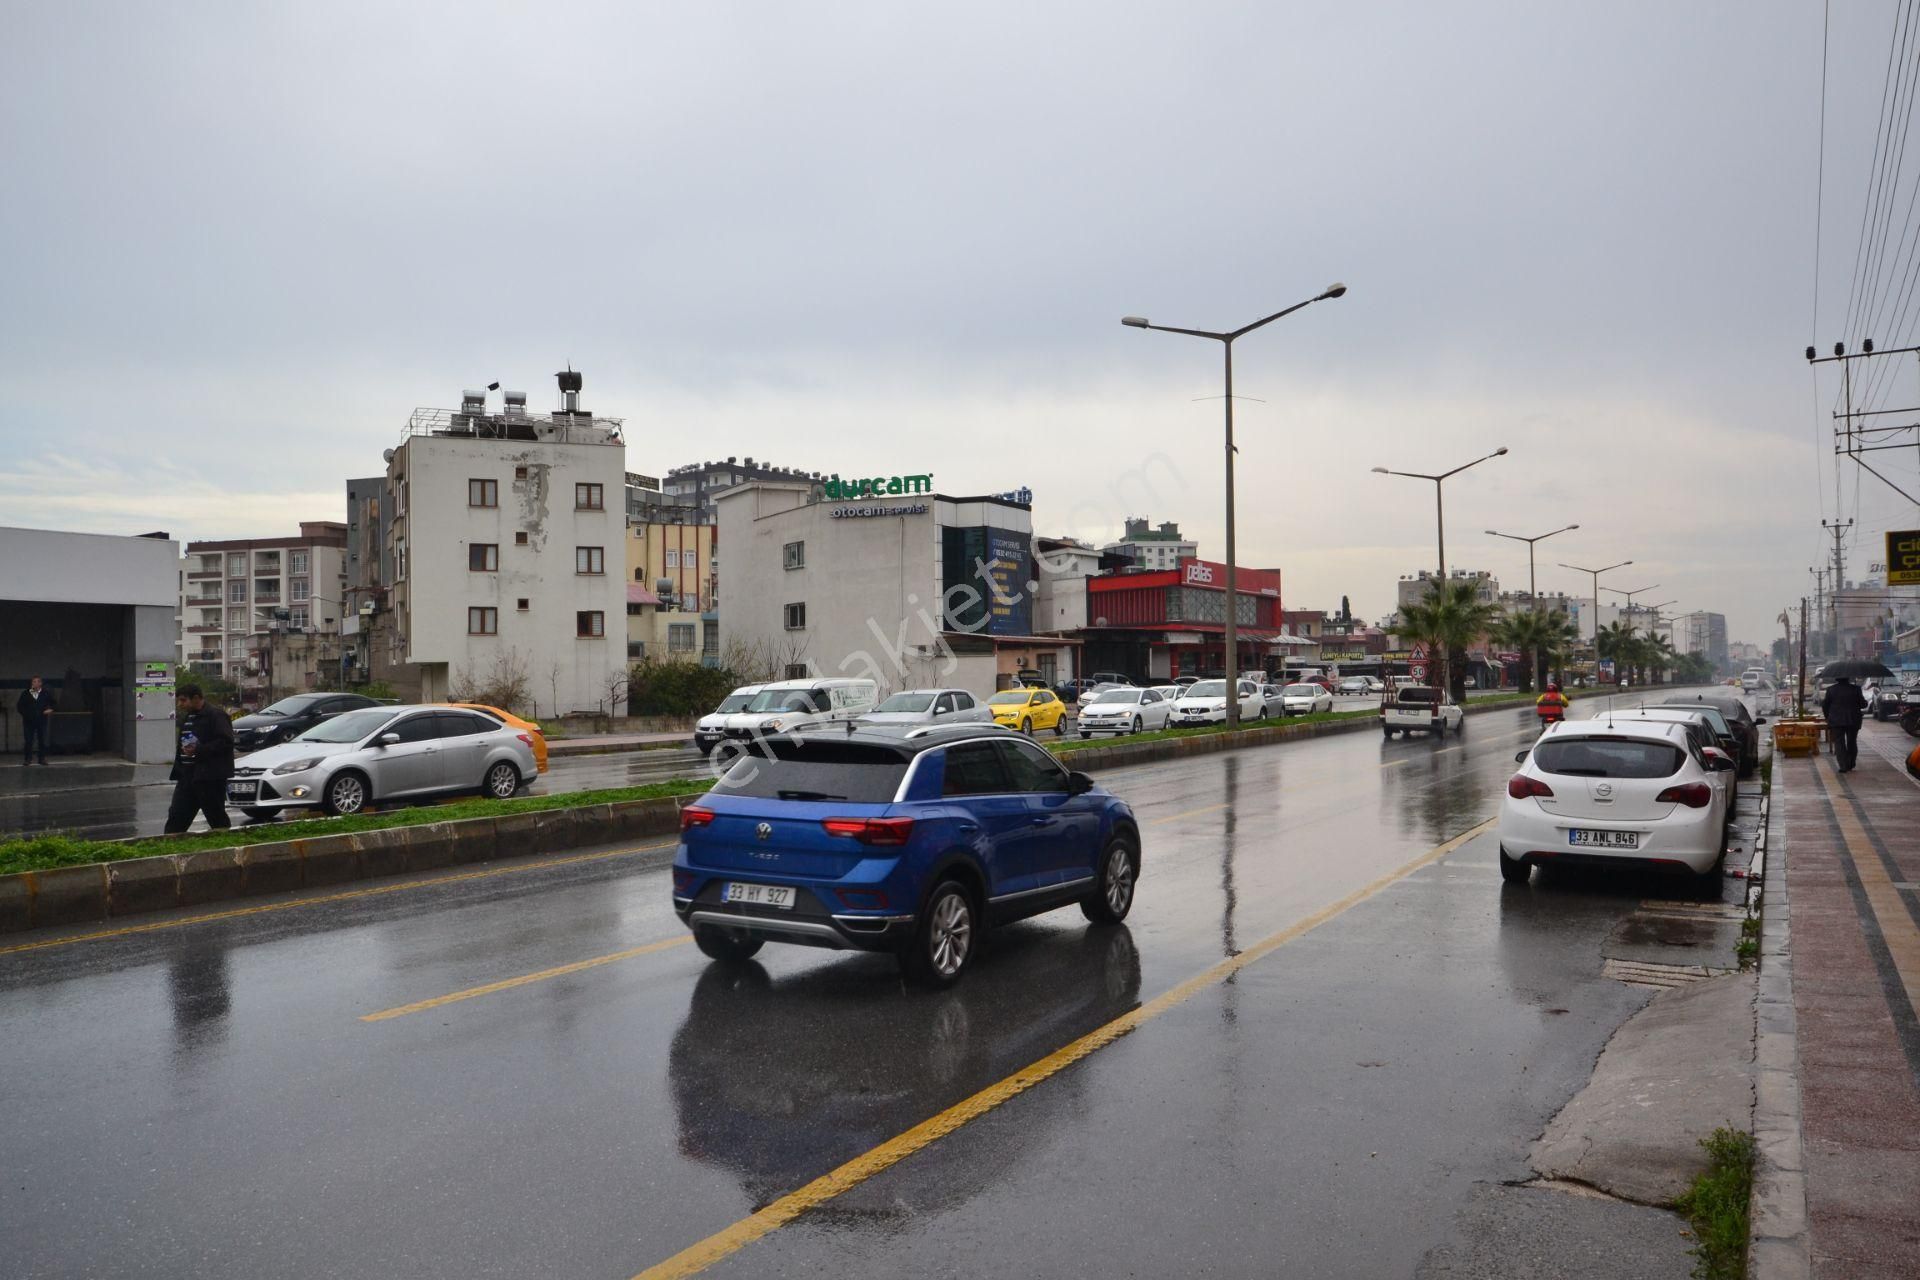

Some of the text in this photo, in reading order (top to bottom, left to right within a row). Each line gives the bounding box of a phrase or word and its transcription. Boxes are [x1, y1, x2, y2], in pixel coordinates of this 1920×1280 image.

[825, 473, 931, 499] durcam
[832, 504, 925, 518] otocam servisi
[1413, 668, 1424, 676] 50
[1576, 831, 1635, 844] 33 ANL 846
[729, 884, 788, 904] 33 HY 927
